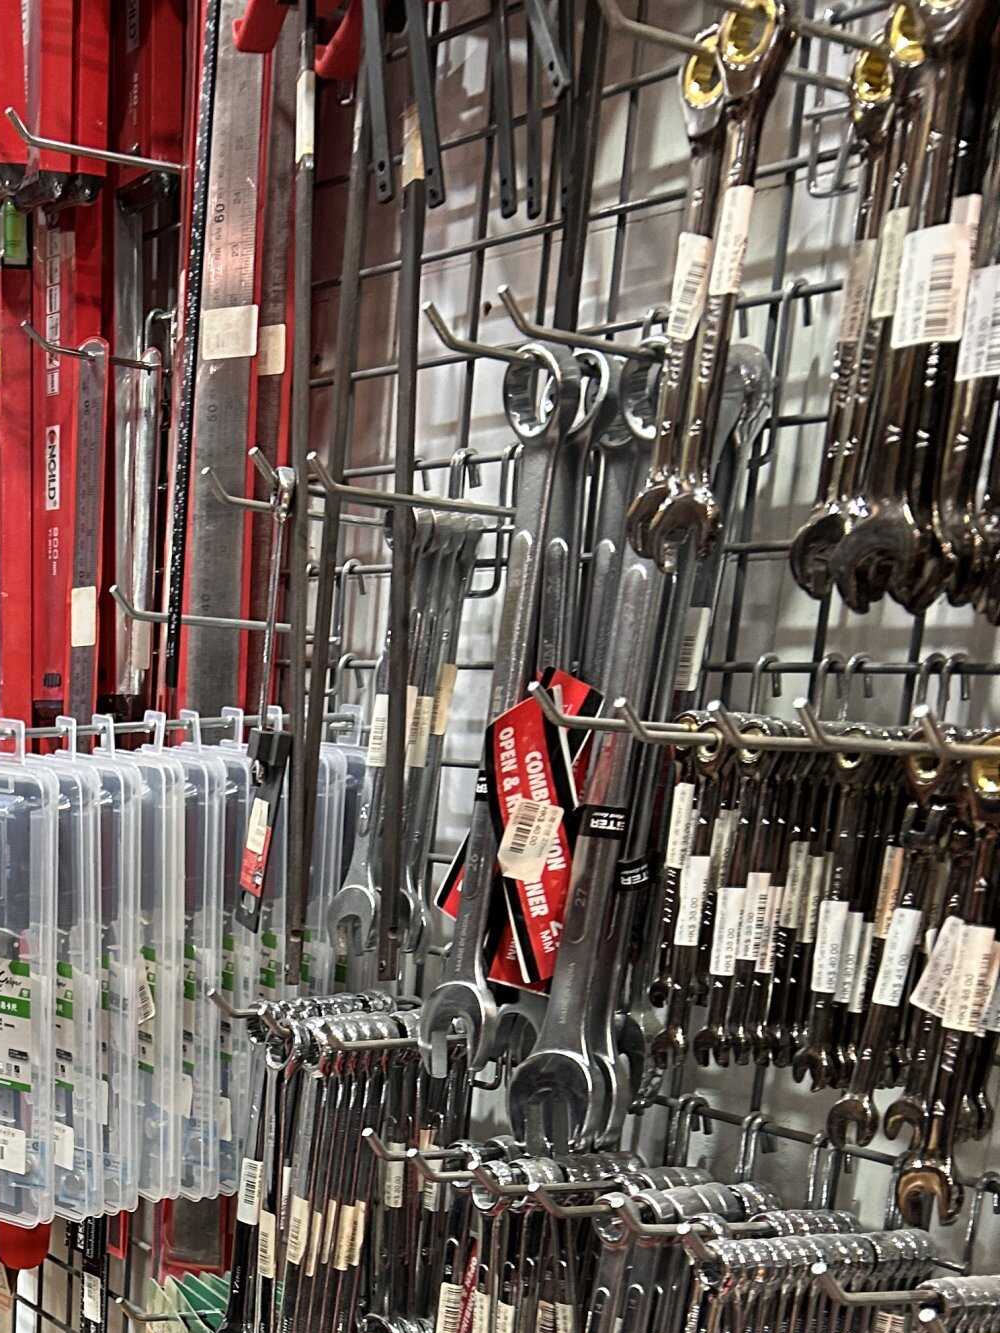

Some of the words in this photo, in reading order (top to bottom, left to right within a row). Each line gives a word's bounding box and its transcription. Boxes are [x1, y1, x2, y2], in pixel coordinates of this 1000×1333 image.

[214, 203, 225, 224] 60
[498, 725, 519, 777] OPEN
[539, 928, 554, 954] MM
